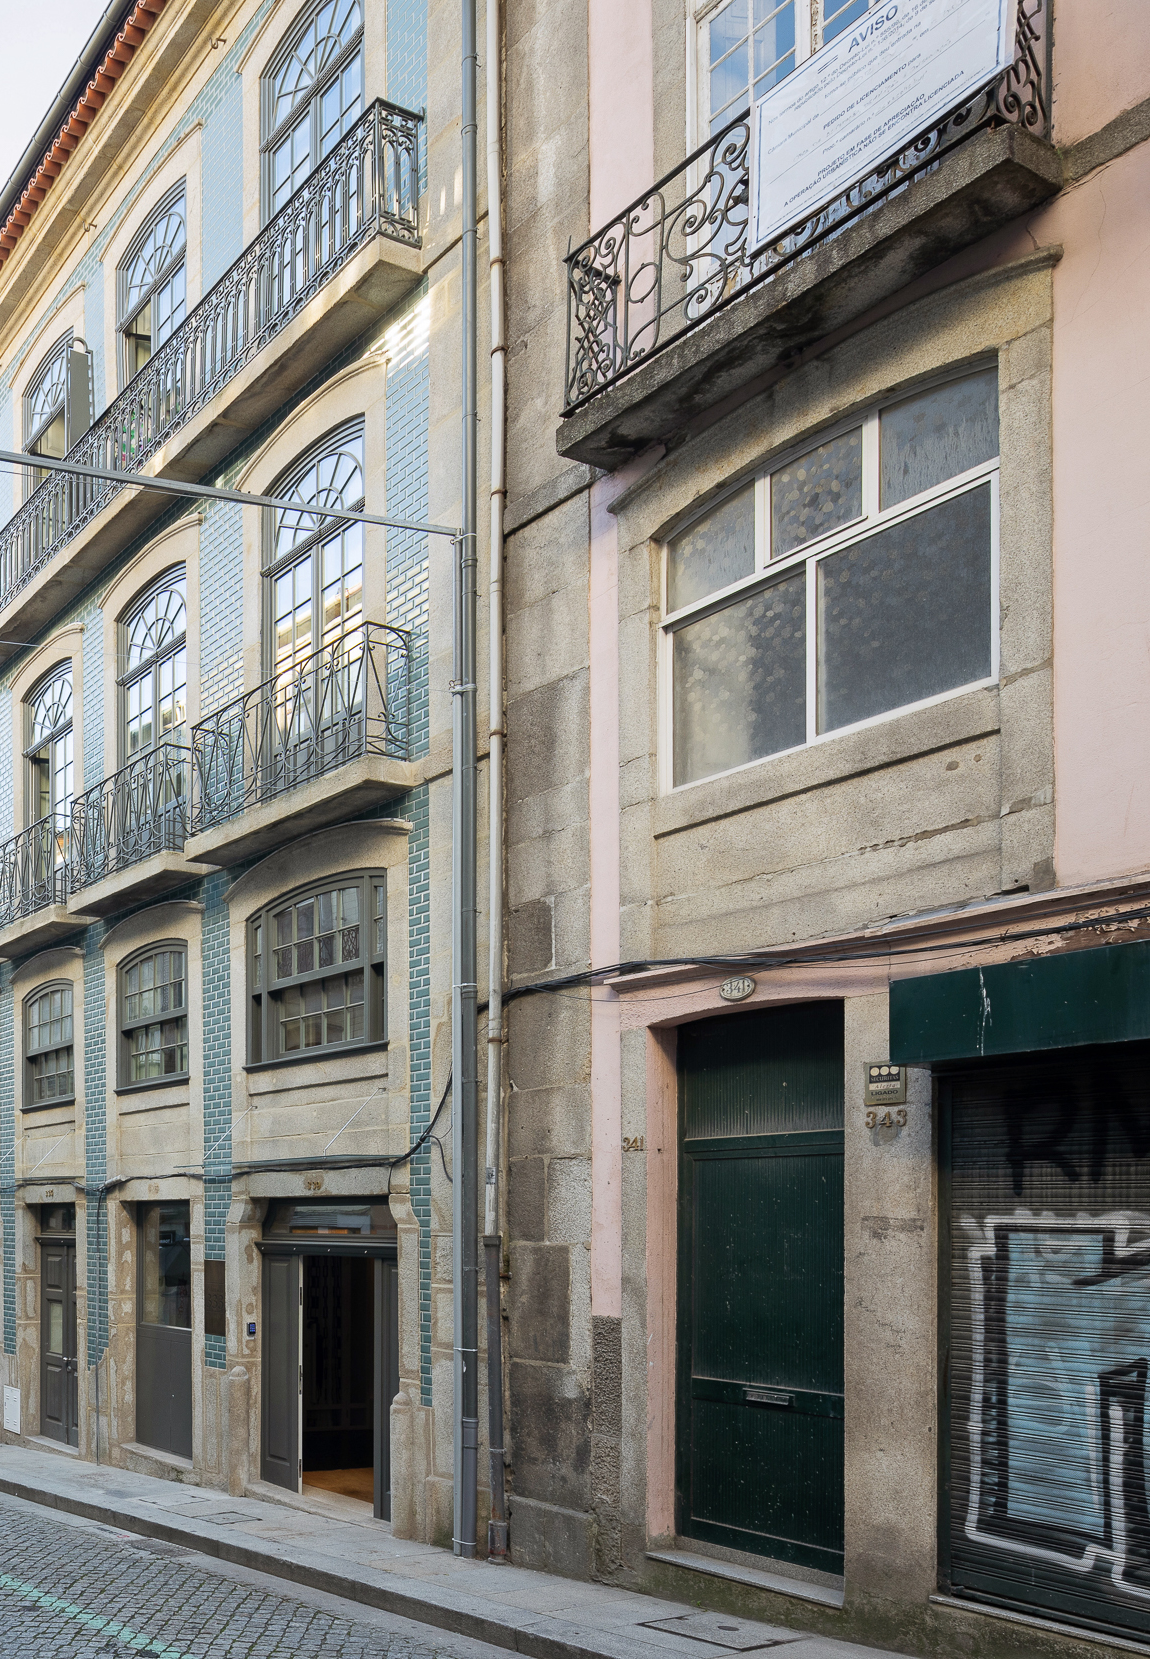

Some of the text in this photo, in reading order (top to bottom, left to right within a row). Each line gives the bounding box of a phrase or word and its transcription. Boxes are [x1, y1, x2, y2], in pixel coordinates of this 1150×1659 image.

[848, 5, 898, 53] AVISO
[823, 110, 845, 130] PEDIDO
[847, 103, 855, 112] DE
[856, 63, 907, 105] LICENCIAMENTO
[907, 53, 921, 66] para
[789, 177, 821, 203] OPERAÇÃO
[822, 147, 862, 179] URBANÍSTICA
[863, 136, 877, 148] NÃO
[878, 129, 886, 138] SE
[888, 102, 922, 130] ENCONTRA
[923, 70, 964, 103] LICENCIADA
[817, 93, 925, 176] PROJETO EM FASE DE APRECIAÇÃO
[725, 980, 746, 994] 341
[865, 1109, 907, 1128] 343
[622, 1136, 644, 1152] 341
